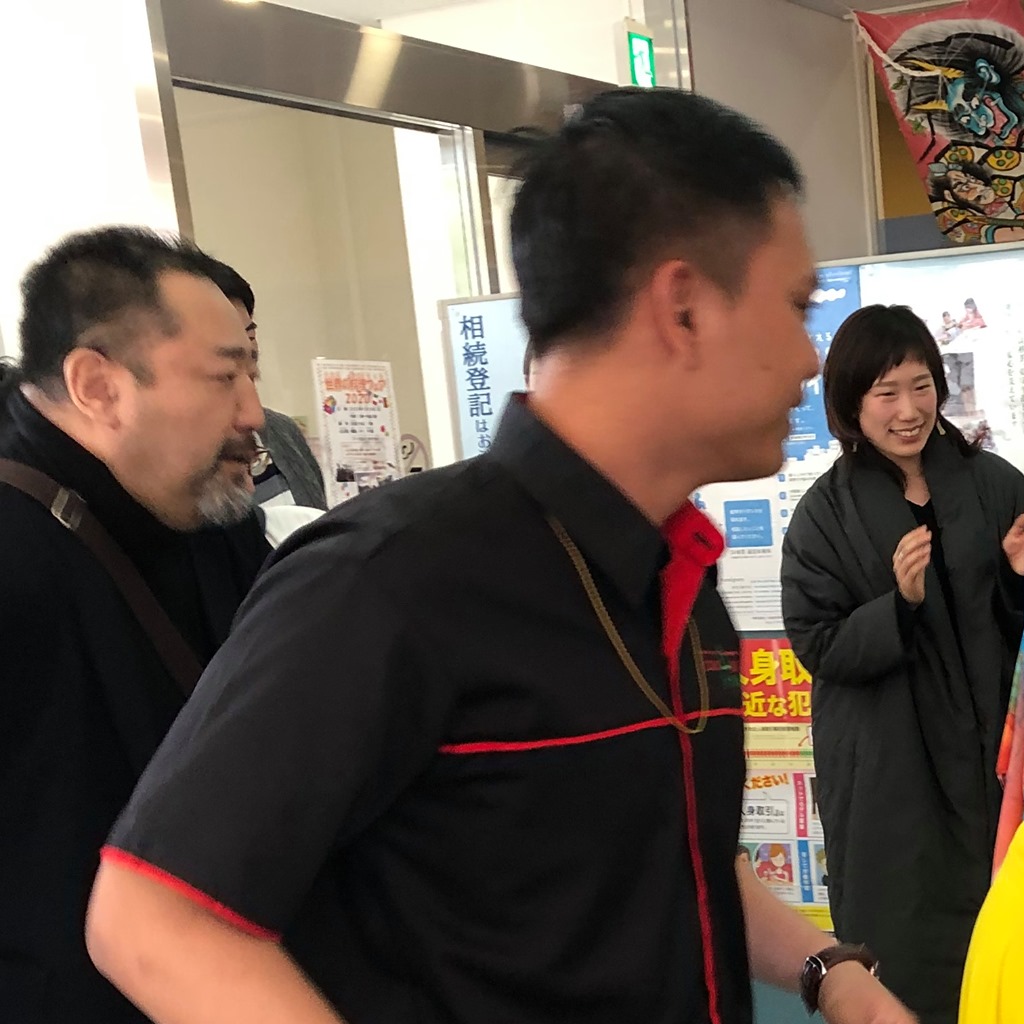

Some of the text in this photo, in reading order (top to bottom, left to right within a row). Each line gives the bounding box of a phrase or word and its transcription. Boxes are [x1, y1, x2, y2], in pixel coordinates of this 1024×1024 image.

[459, 315, 492, 452] 相続登記はお
[742, 691, 811, 717] 近な犯
